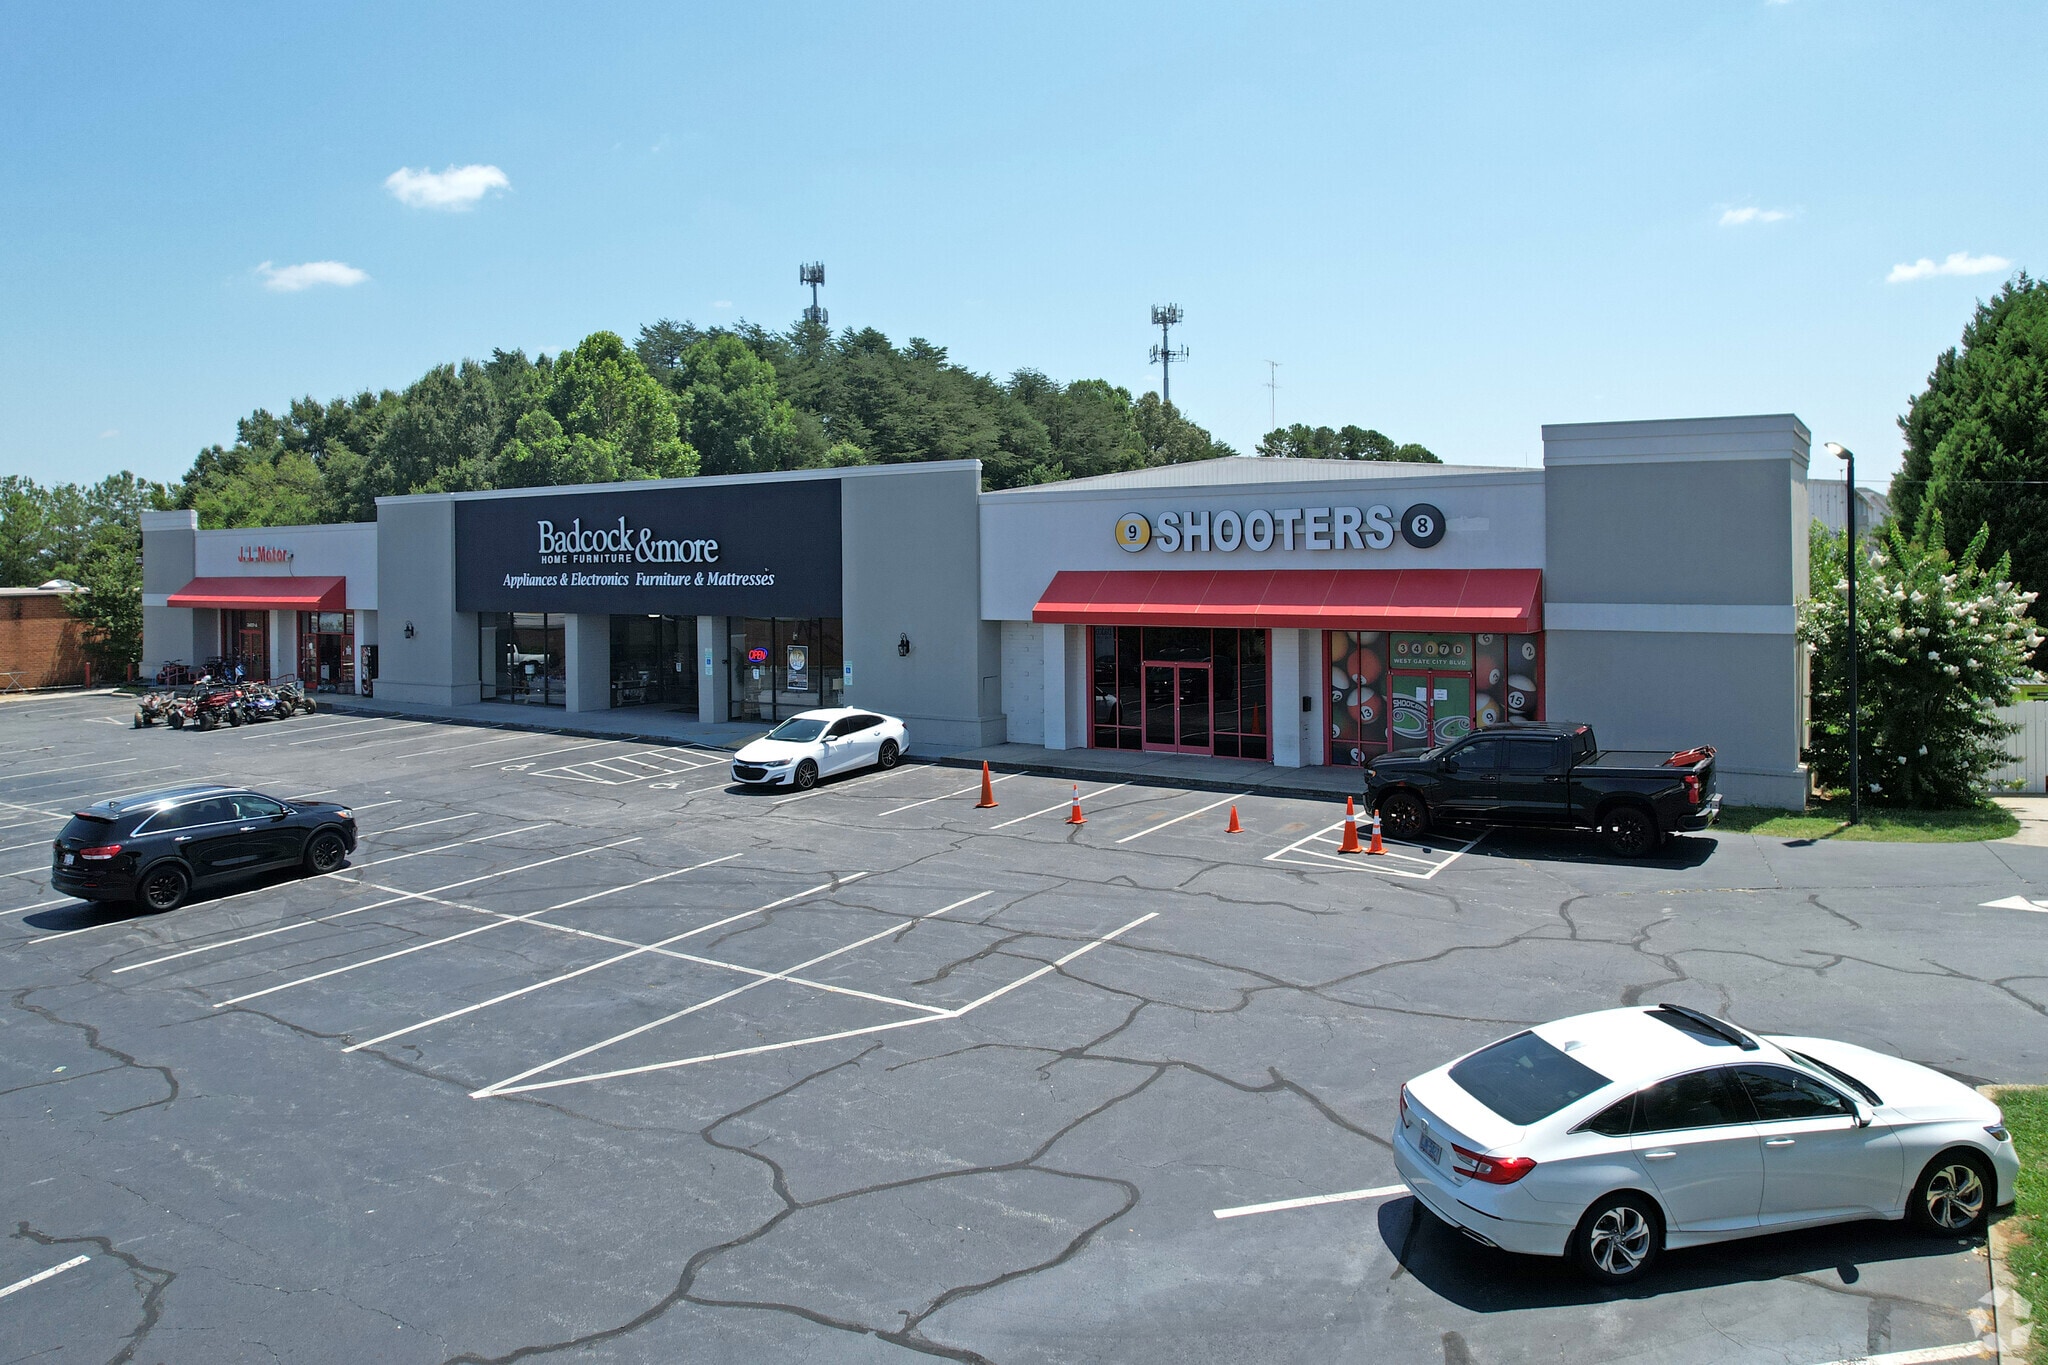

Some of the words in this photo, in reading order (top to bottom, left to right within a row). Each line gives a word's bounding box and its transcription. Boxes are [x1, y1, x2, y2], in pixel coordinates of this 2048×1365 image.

[537, 516, 635, 553] Badcock
[1156, 504, 1395, 553] SHOOTERS
[258, 545, 287, 562] Motor
[541, 555, 568, 564] HOME
[573, 553, 632, 564] FURNITURE
[503, 572, 558, 589] Appliances
[559, 572, 568, 586] &
[571, 572, 629, 586] Electronics
[635, 572, 691, 586] Furniture
[694, 571, 704, 586] &
[707, 571, 775, 586] Mattresses
[748, 649, 767, 661] OPEN
[1509, 694, 1523, 706] 15
